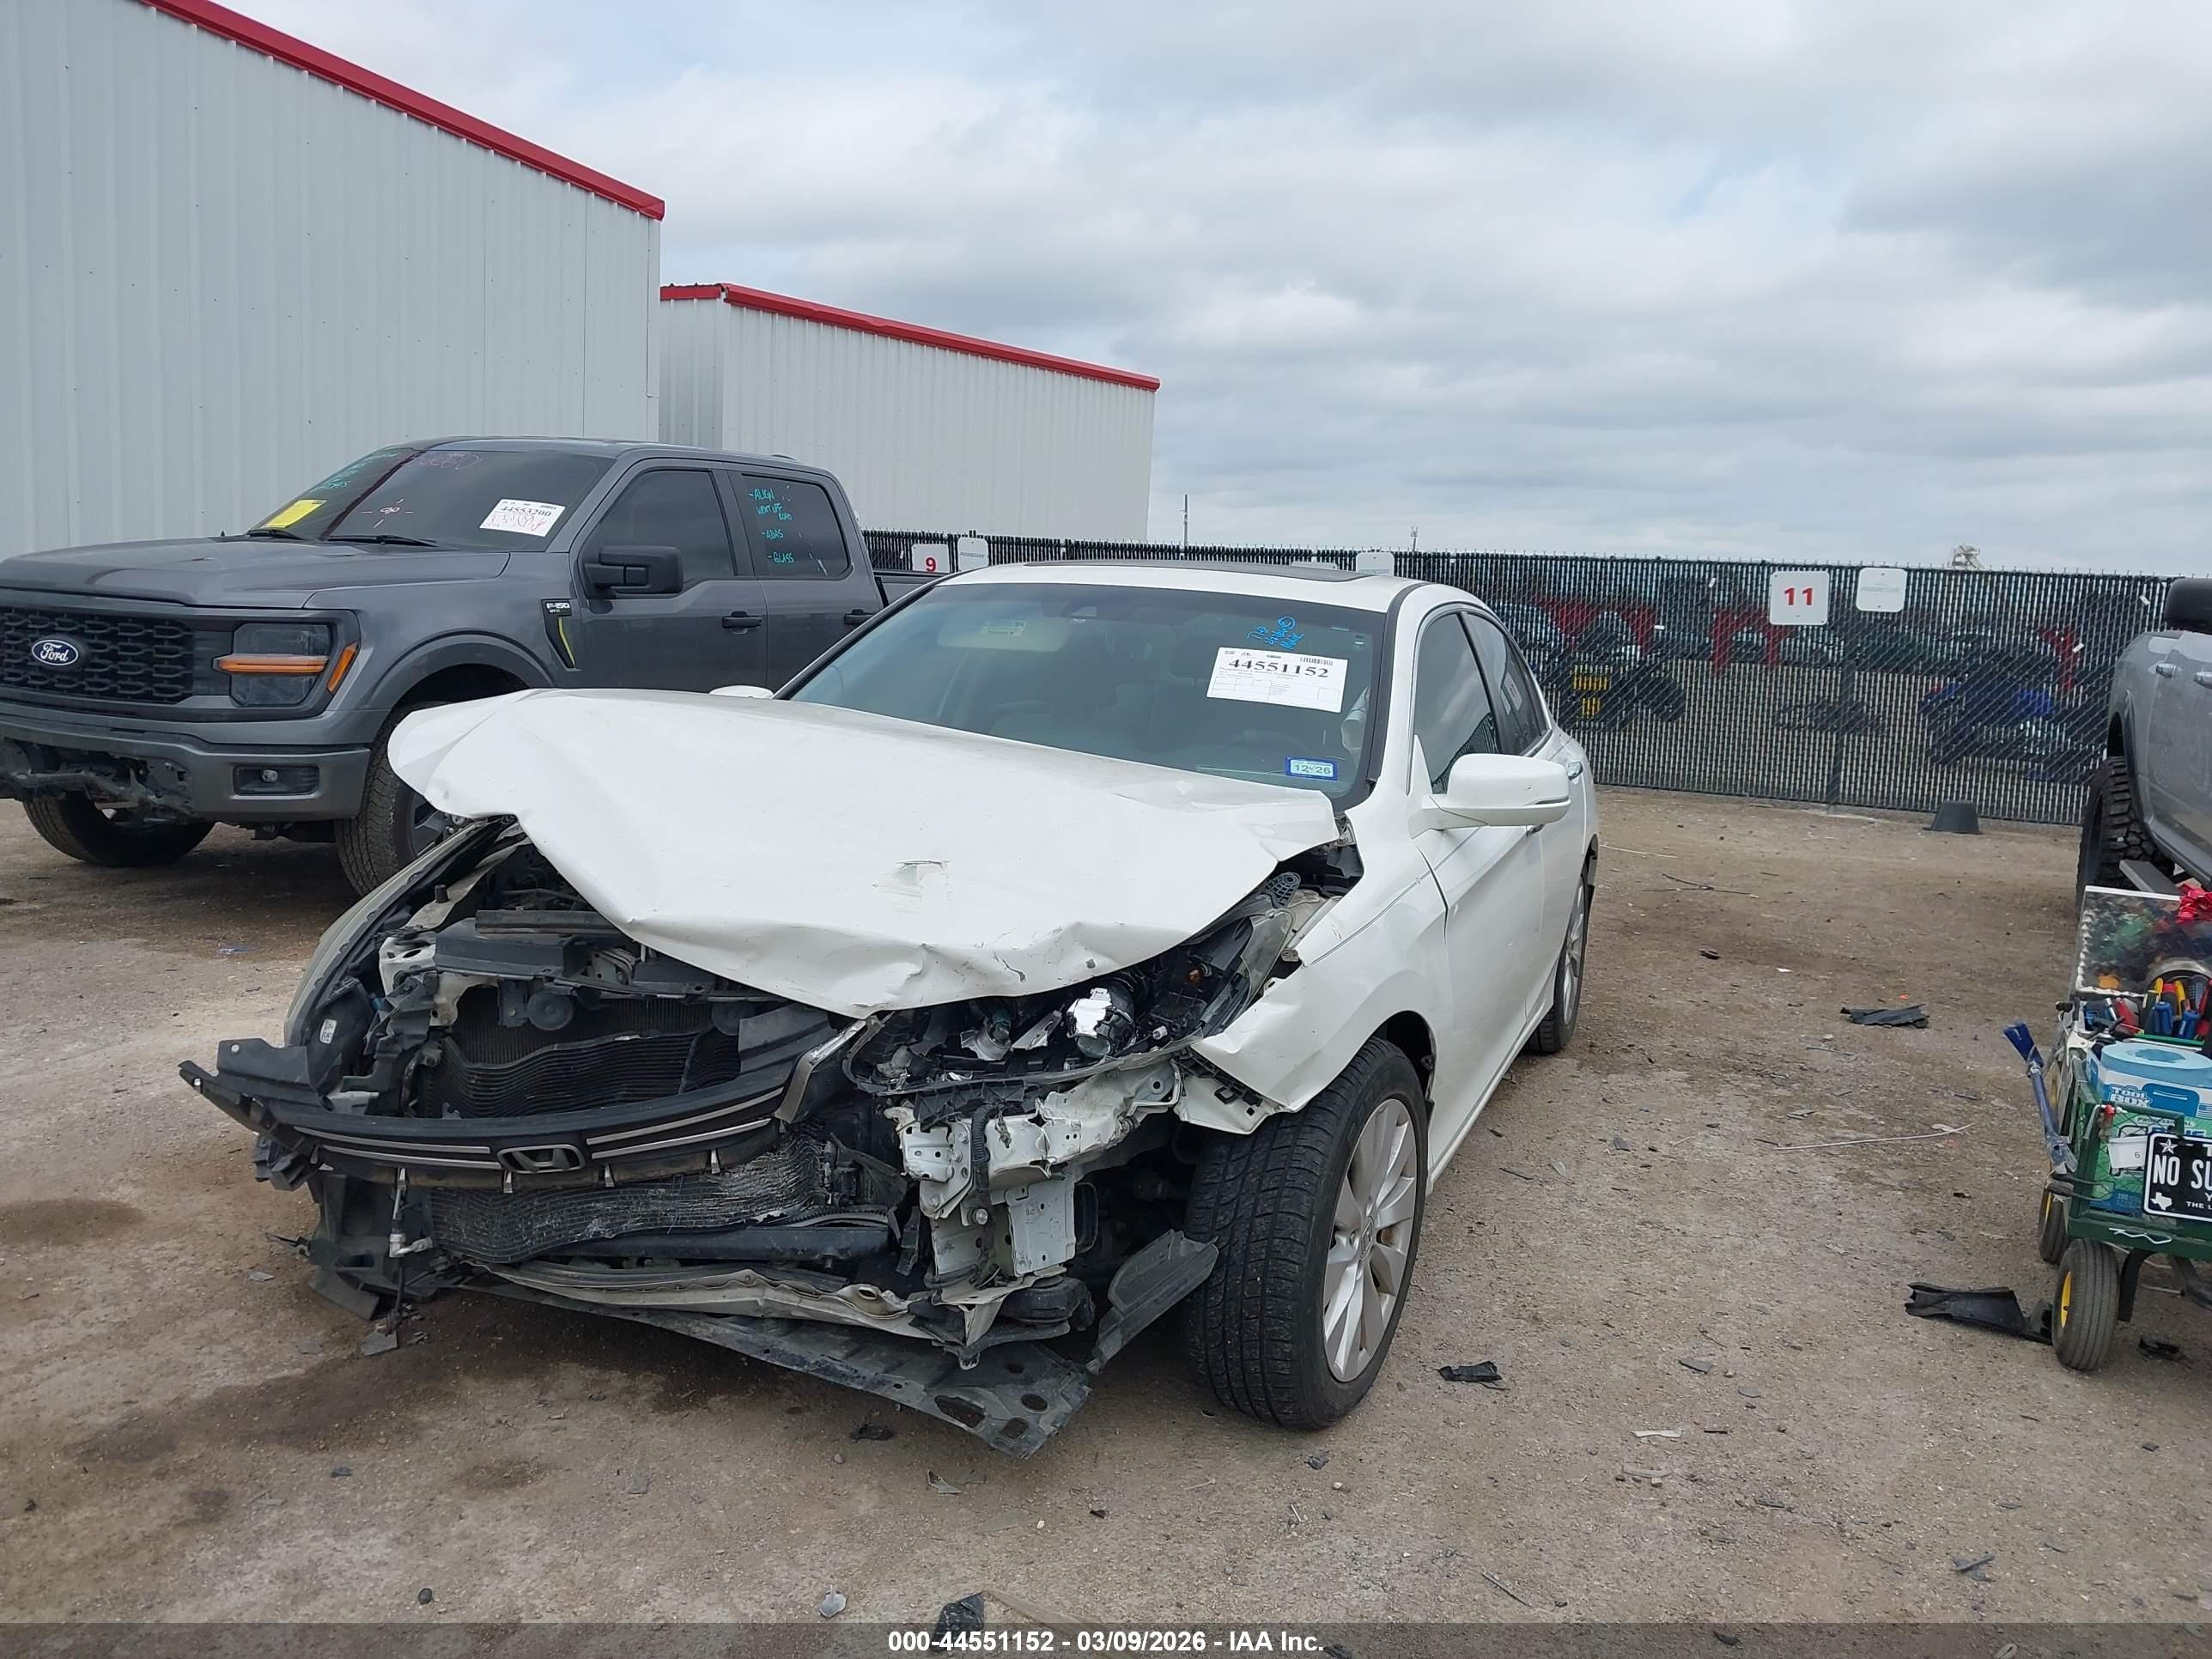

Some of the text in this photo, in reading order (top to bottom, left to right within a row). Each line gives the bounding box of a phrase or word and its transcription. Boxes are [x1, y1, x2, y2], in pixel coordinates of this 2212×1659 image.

[926, 556, 937, 572] 9
[1784, 587, 1814, 605] 11
[40, 642, 70, 662] Ford
[1229, 659, 1328, 678] 44551152
[1295, 764, 1310, 773] 12
[2110, 1093, 2151, 1108] BOX
[2112, 1086, 2148, 1100] TOOL
[2134, 1151, 2141, 1159] 6
[2153, 1154, 2181, 1186] NO
